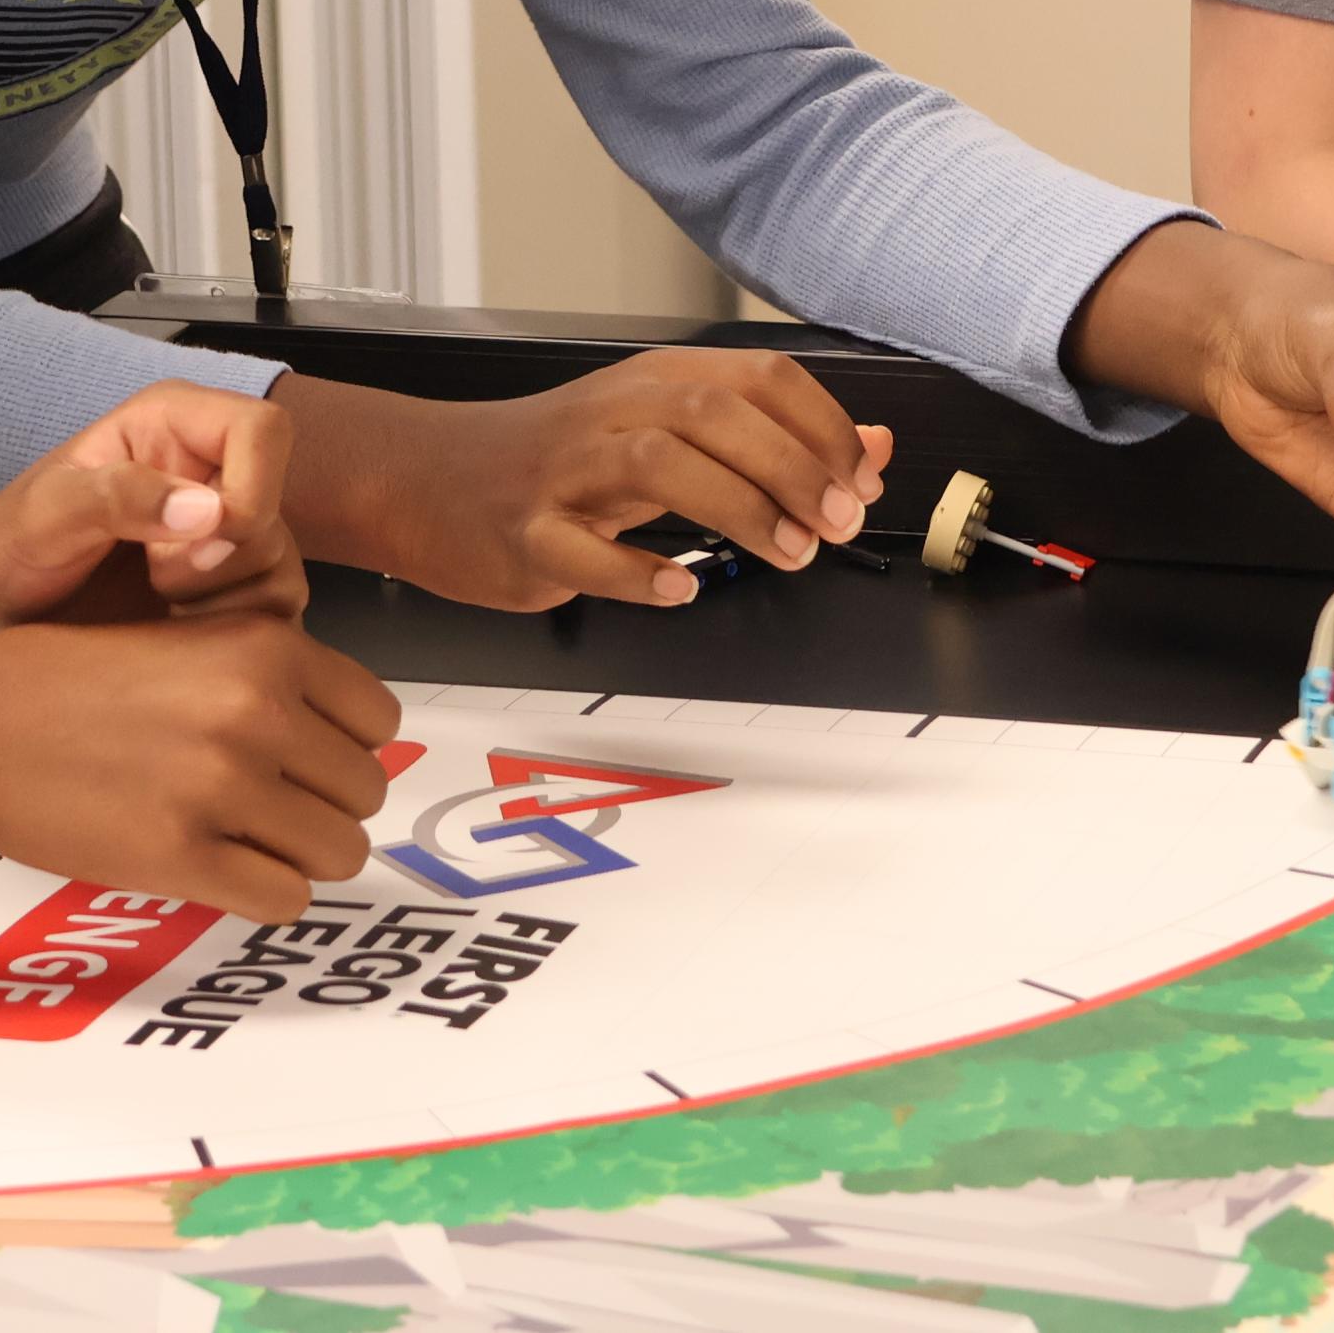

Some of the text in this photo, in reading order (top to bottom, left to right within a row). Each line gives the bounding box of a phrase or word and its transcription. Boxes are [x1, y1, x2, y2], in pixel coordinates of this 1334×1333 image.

[122, 898, 376, 1050] LEAGUE
[297, 903, 479, 1006] LEGO
[396, 911, 580, 1030] FIRST
